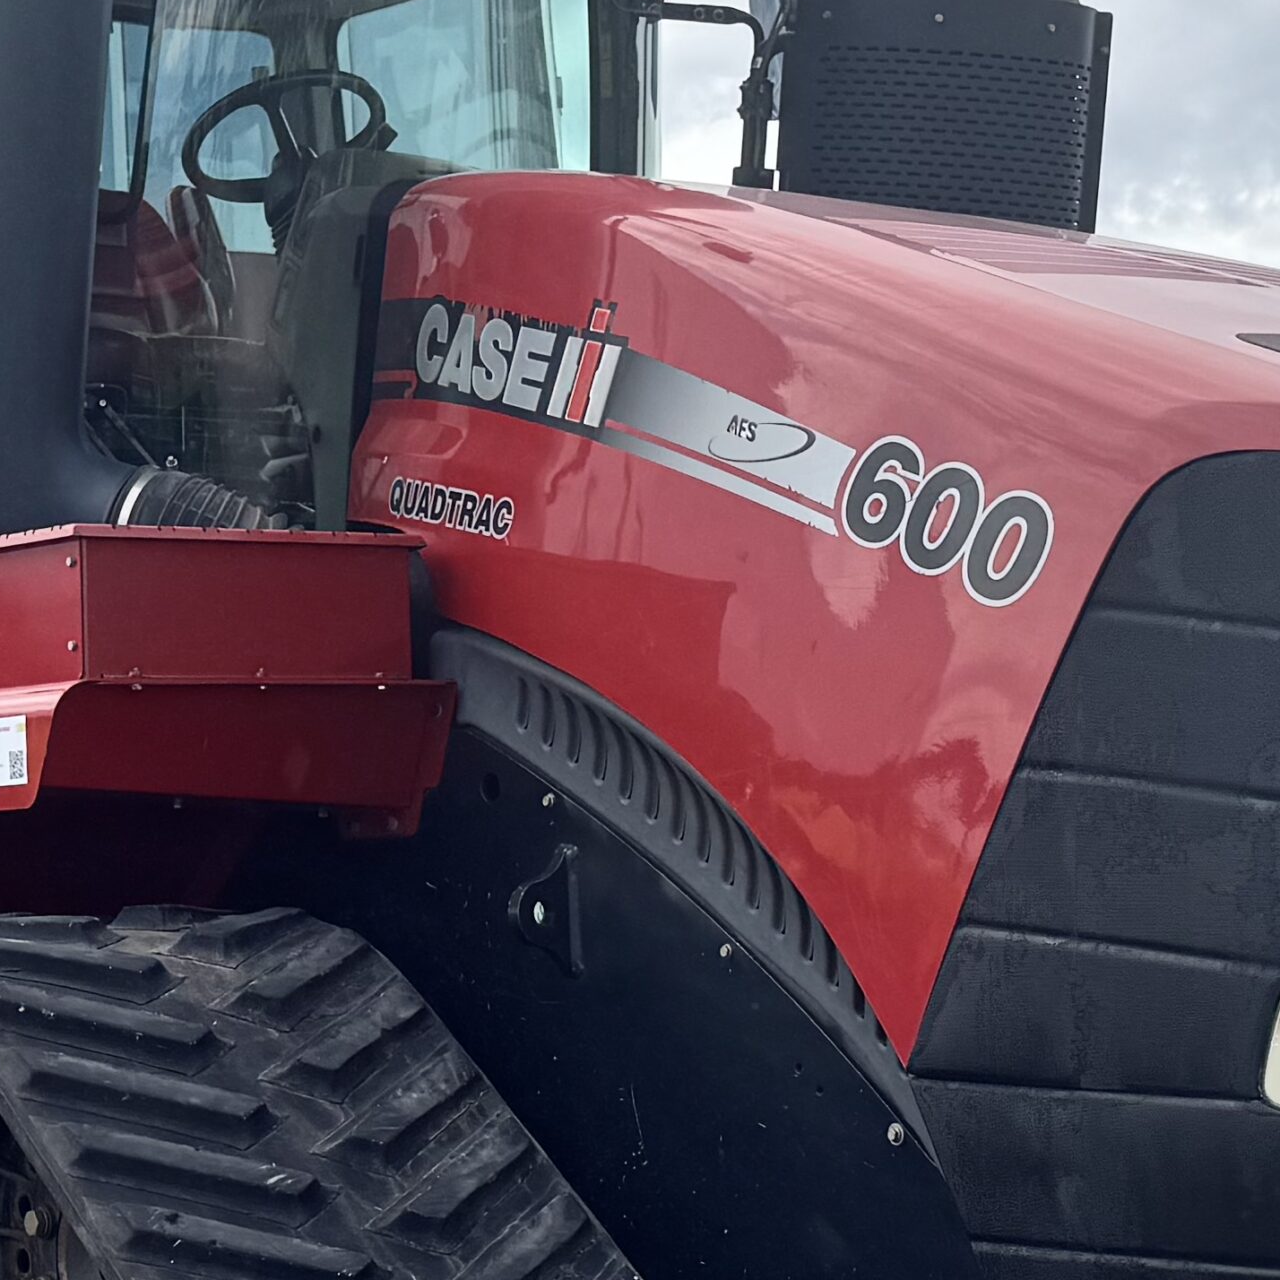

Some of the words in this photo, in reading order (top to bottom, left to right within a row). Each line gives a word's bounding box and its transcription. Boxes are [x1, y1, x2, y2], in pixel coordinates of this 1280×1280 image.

[416, 303, 557, 413] CASE
[388, 476, 515, 540] QUADTRAC
[841, 434, 1054, 608] 600
